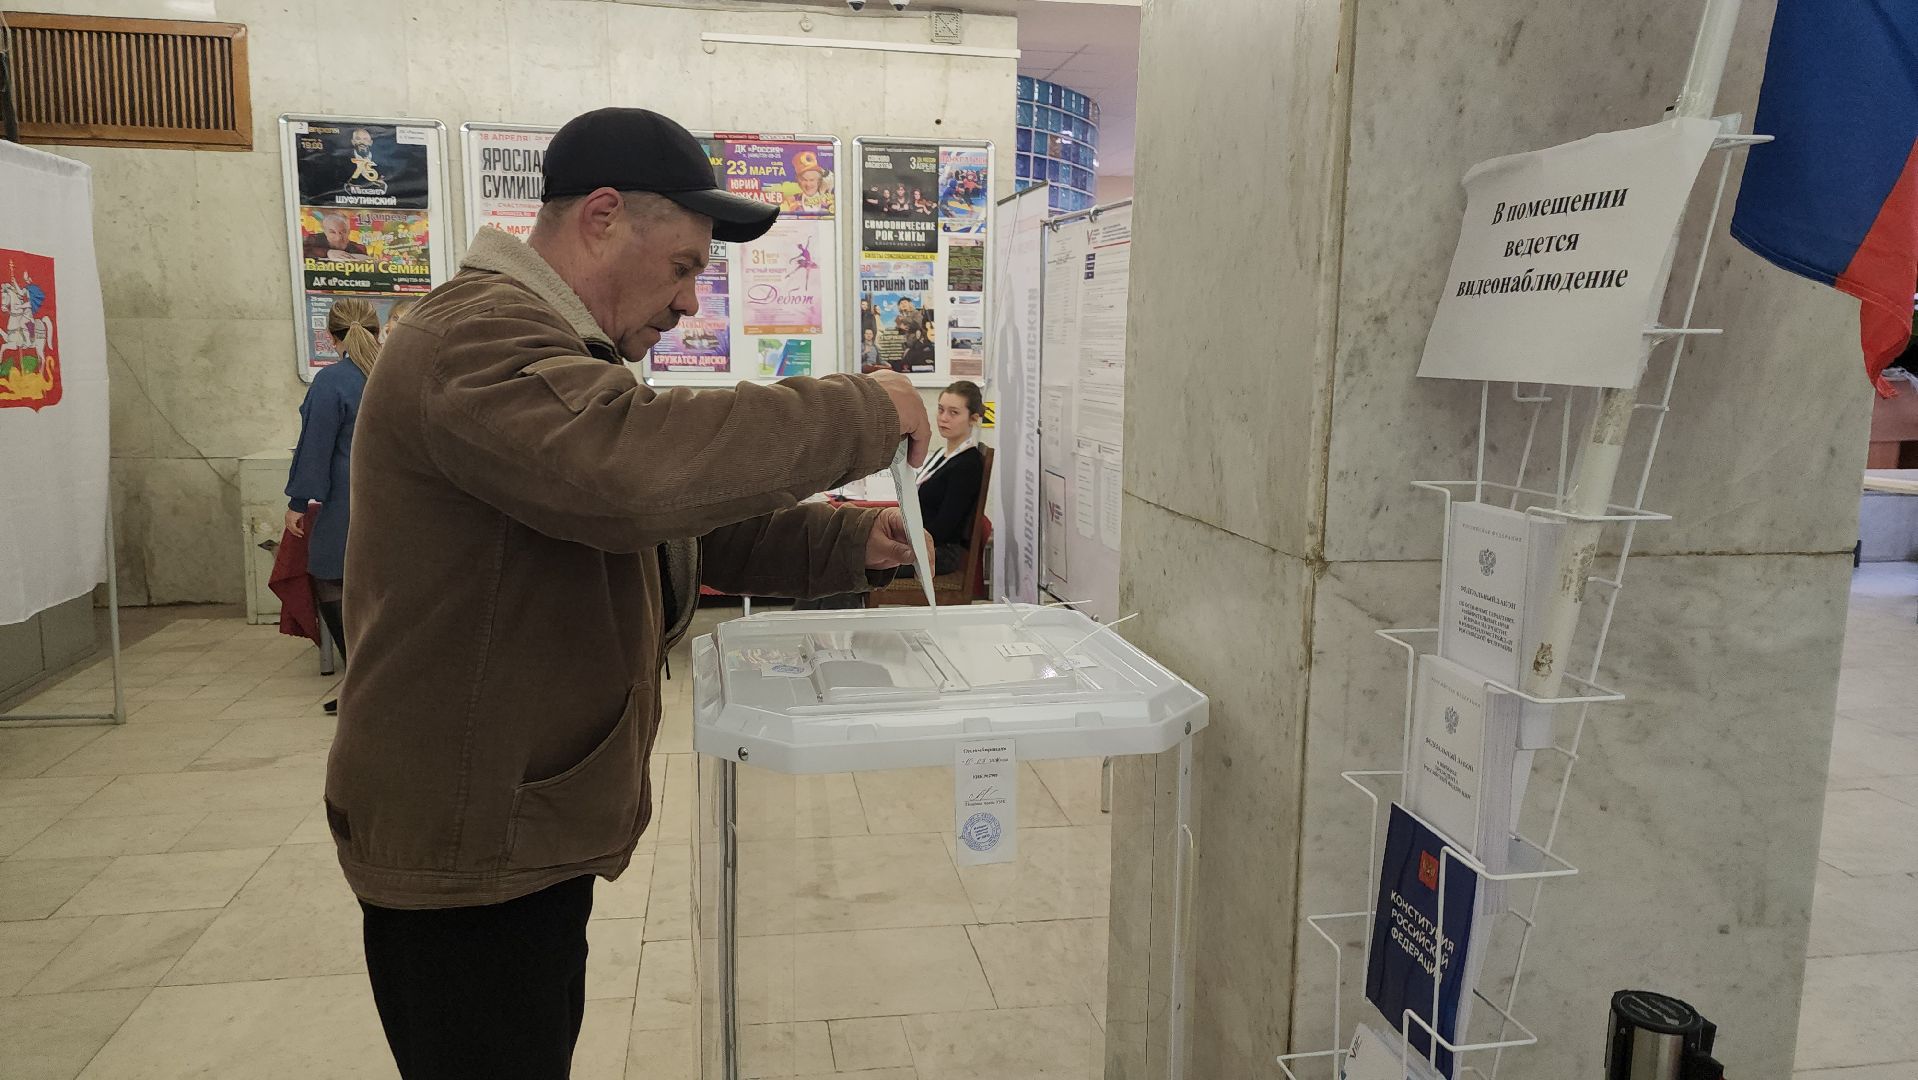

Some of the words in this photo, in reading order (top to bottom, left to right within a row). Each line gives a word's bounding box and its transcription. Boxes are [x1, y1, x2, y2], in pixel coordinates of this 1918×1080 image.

[734, 144, 747, 154] ДК
[726, 160, 747, 175] 23
[749, 166, 787, 177] МАРТА
[909, 156, 917, 170] 3
[730, 177, 759, 190] ЮРИЙ
[335, 195, 397, 206] ШУФУТИНСКИЙ
[1490, 201, 1506, 225] В
[1506, 187, 1630, 223] помещении
[864, 219, 936, 231] СИМФОНИЧЕСКИЕ
[875, 230, 926, 242] РОК-ХИТЫ
[1503, 233, 1581, 259] ведется
[752, 249, 766, 265] 31
[304, 258, 374, 276] Валерий
[312, 277, 327, 287] ДК
[862, 276, 906, 291] СТАРШИЙ
[908, 278, 929, 291] СЫН
[1455, 268, 1630, 298] видеонаблюдение
[747, 283, 814, 305] Дебют
[1391, 908, 1449, 969] РОССИЙСКЙ
